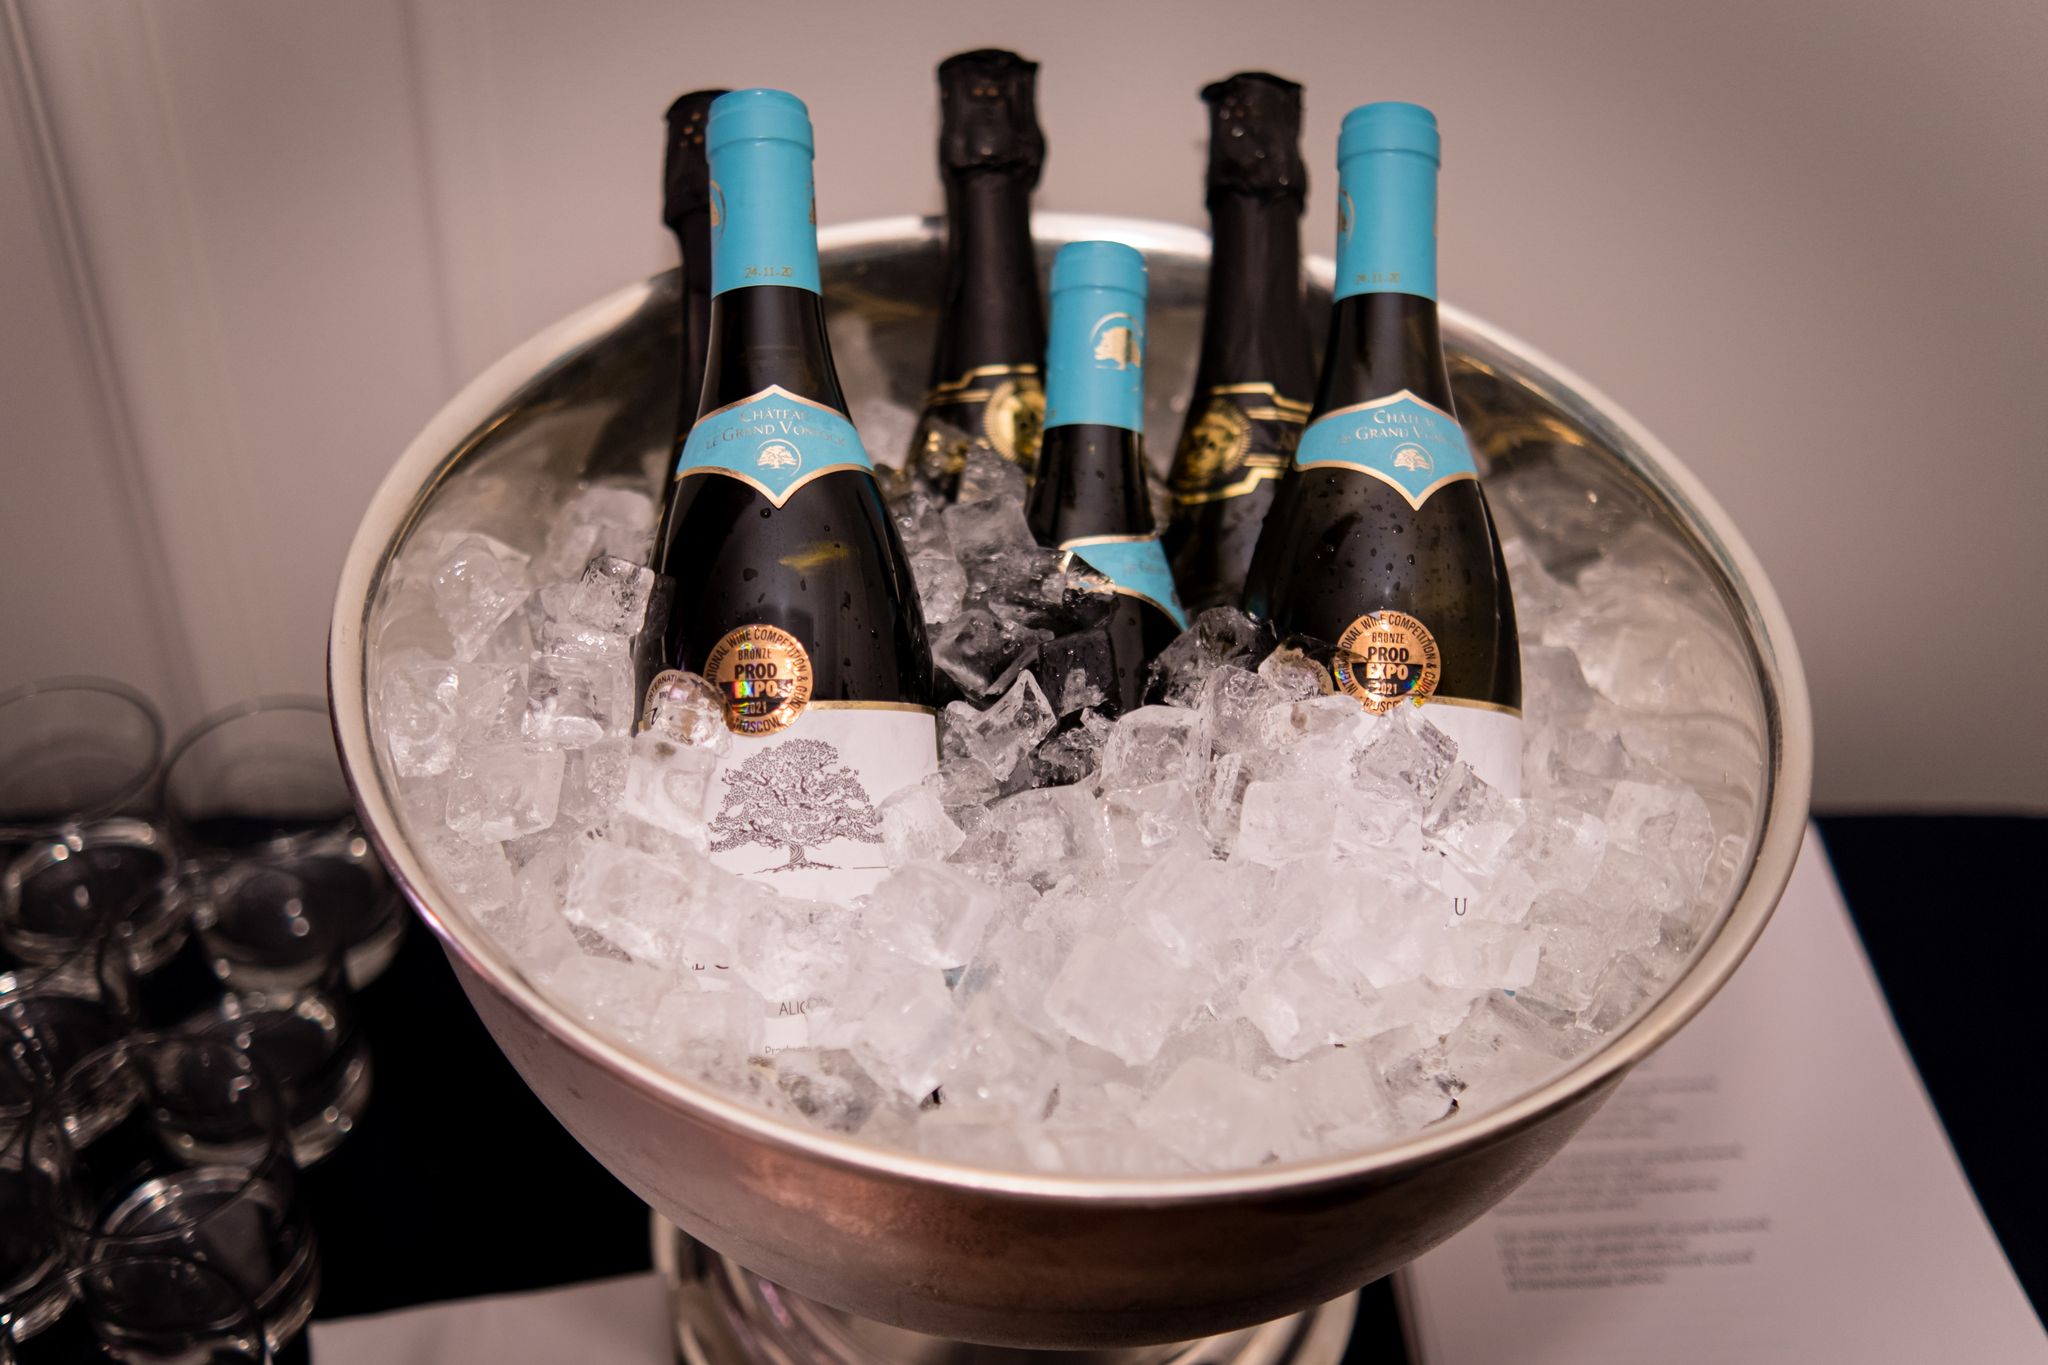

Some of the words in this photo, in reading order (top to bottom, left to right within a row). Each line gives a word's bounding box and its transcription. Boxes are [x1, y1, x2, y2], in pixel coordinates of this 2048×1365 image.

[726, 629, 752, 650] WINE
[1371, 632, 1406, 644] BRONZE
[1388, 613, 1437, 660] COMPETITION
[738, 648, 772, 660] BRONZE
[1367, 646, 1409, 662] PROD
[734, 662, 778, 680] PROD
[1366, 663, 1409, 681] EXPO
